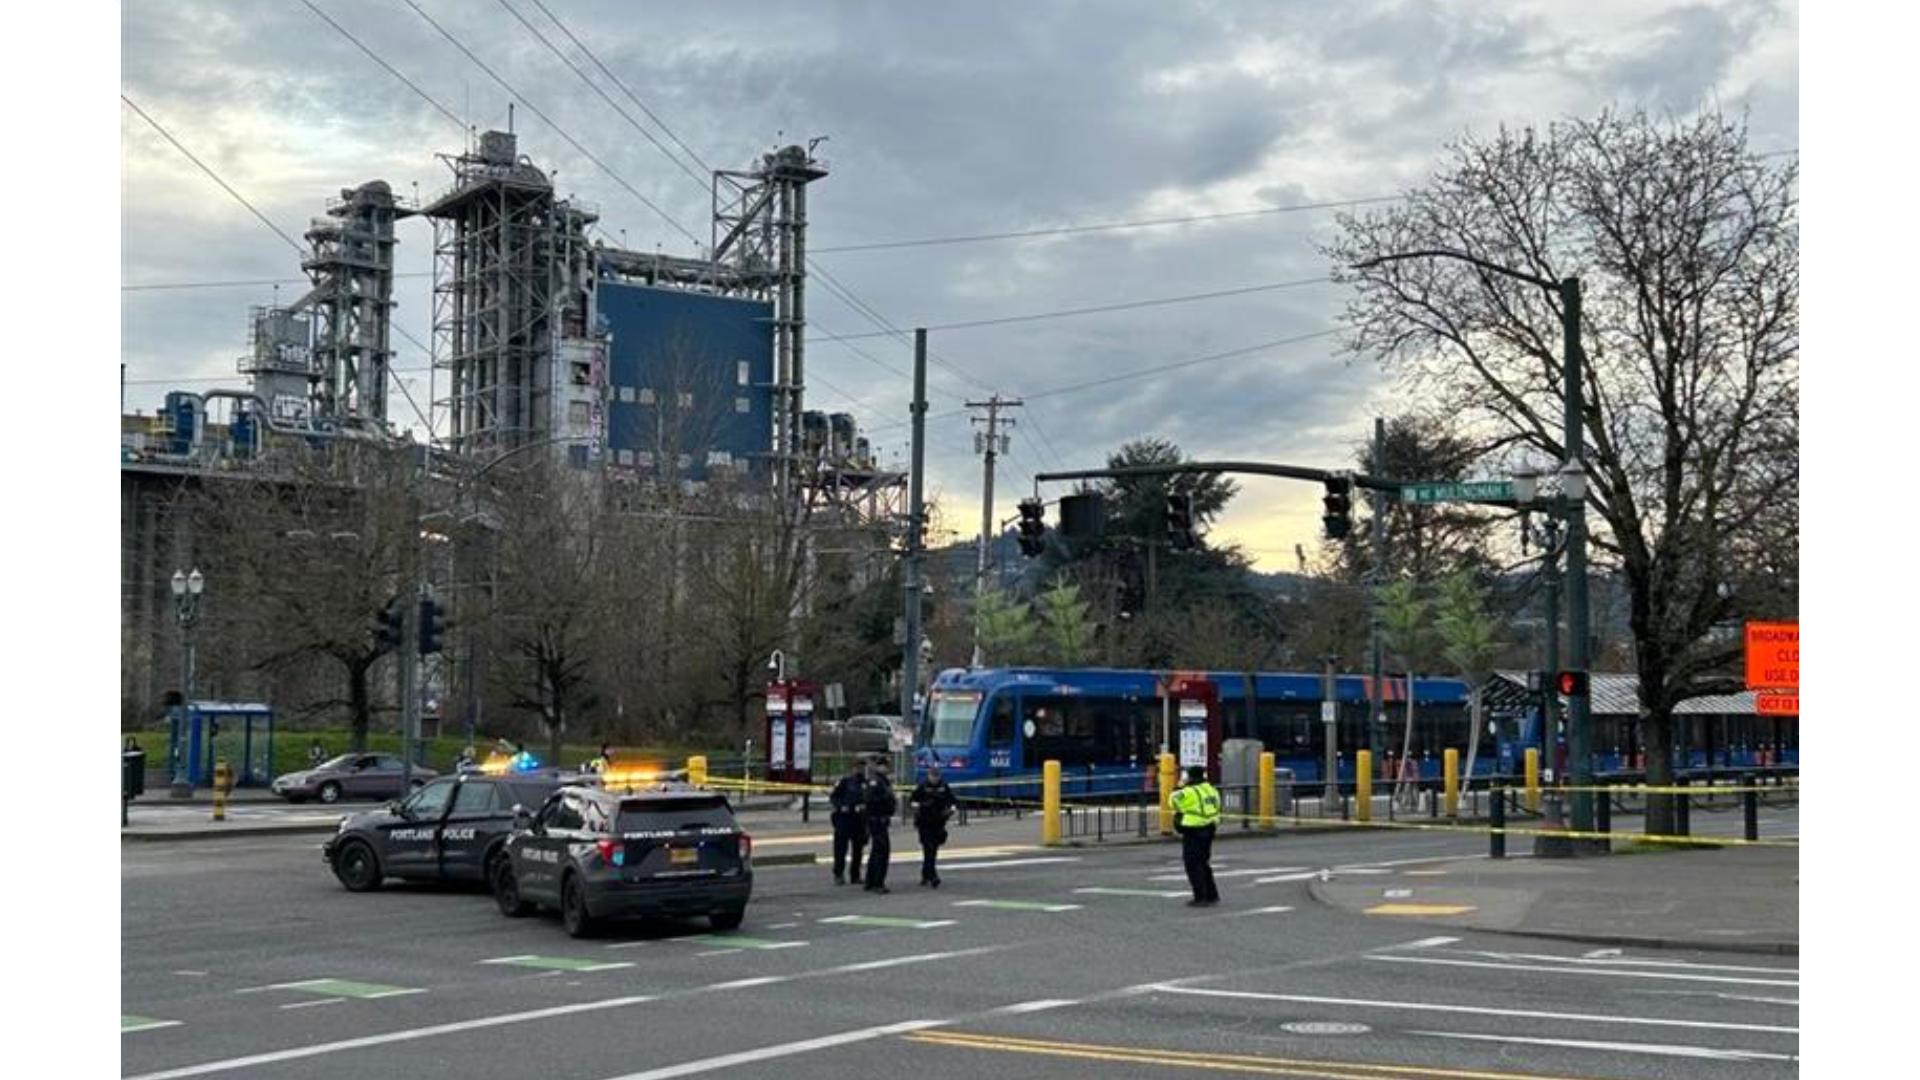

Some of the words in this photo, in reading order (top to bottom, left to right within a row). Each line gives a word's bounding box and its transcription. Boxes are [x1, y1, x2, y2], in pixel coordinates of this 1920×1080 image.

[1764, 669, 1786, 682] USE
[390, 829, 434, 840] PORTLAND
[441, 829, 475, 840] POLICE
[623, 831, 675, 839] PORTLAND
